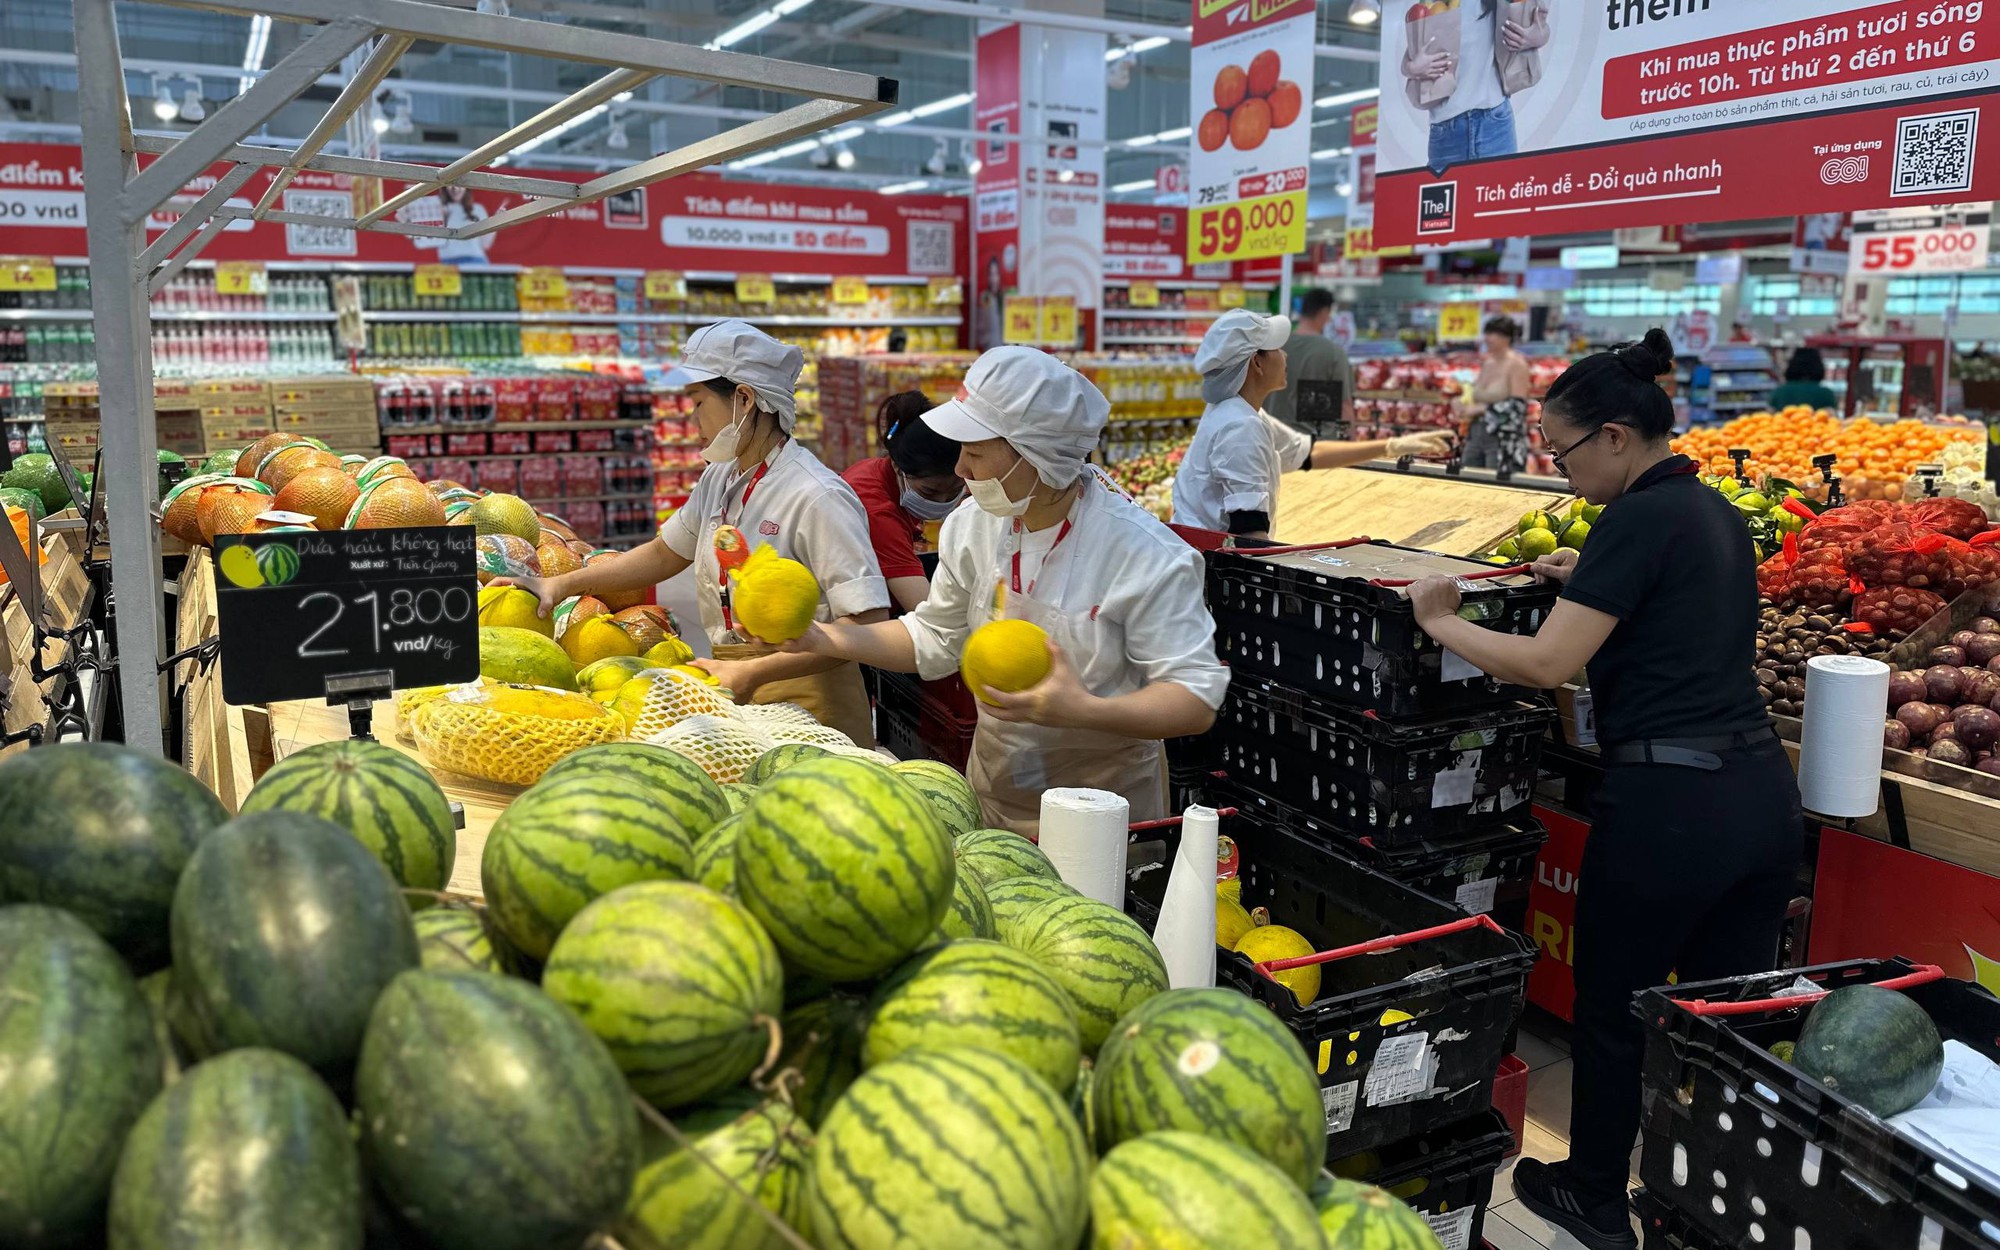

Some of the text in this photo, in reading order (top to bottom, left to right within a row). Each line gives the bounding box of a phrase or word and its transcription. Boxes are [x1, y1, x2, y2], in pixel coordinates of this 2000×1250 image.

[1640, 0, 1984, 79] Khi mua thực phẩm tươi sống
[1640, 31, 1976, 105] trước 10h. Từ thứ 2 đến thứ 6
[1649, 117, 1671, 128] dụng
[1672, 113, 1690, 124] cho
[1692, 109, 1713, 121] toàn
[1937, 72, 1958, 86] trái
[1960, 68, 1990, 83] cây)
[1813, 140, 1882, 156] Tại ứng dụng
[1820, 155, 1869, 185] GO!
[1476, 184, 1506, 203] Tích
[1510, 176, 1547, 199] điểm
[1552, 173, 1572, 195] dễ
[1588, 166, 1619, 191] Đổi
[1623, 167, 1657, 191] quà
[1663, 159, 1722, 183] nhanh
[35, 203, 78, 218] vnd
[1198, 199, 1294, 256] 59.000
[1862, 232, 1977, 271] 55.000
[298, 587, 471, 657] 21.800
